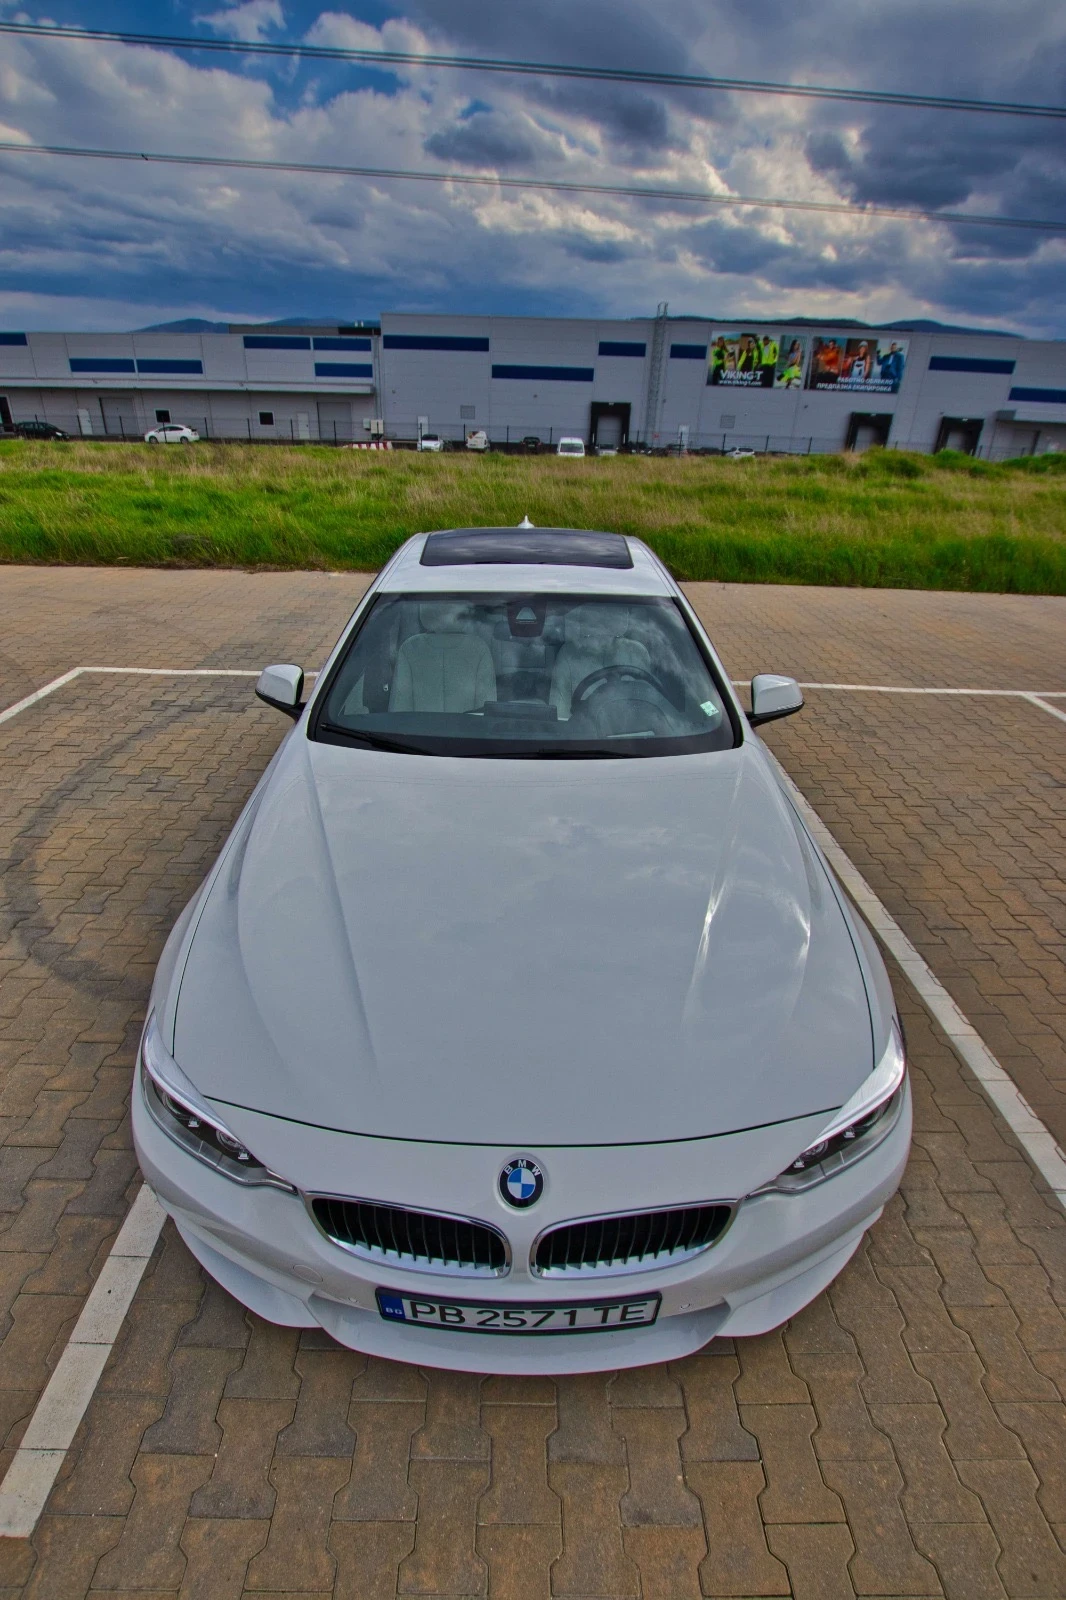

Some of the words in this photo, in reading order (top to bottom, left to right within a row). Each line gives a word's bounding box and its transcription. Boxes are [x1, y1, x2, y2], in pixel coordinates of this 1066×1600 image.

[503, 1160, 540, 1175] BMW
[385, 1307, 403, 1315] BG
[410, 1301, 465, 1324] PB
[477, 1310, 577, 1327] 2571
[594, 1302, 647, 1324] TE
